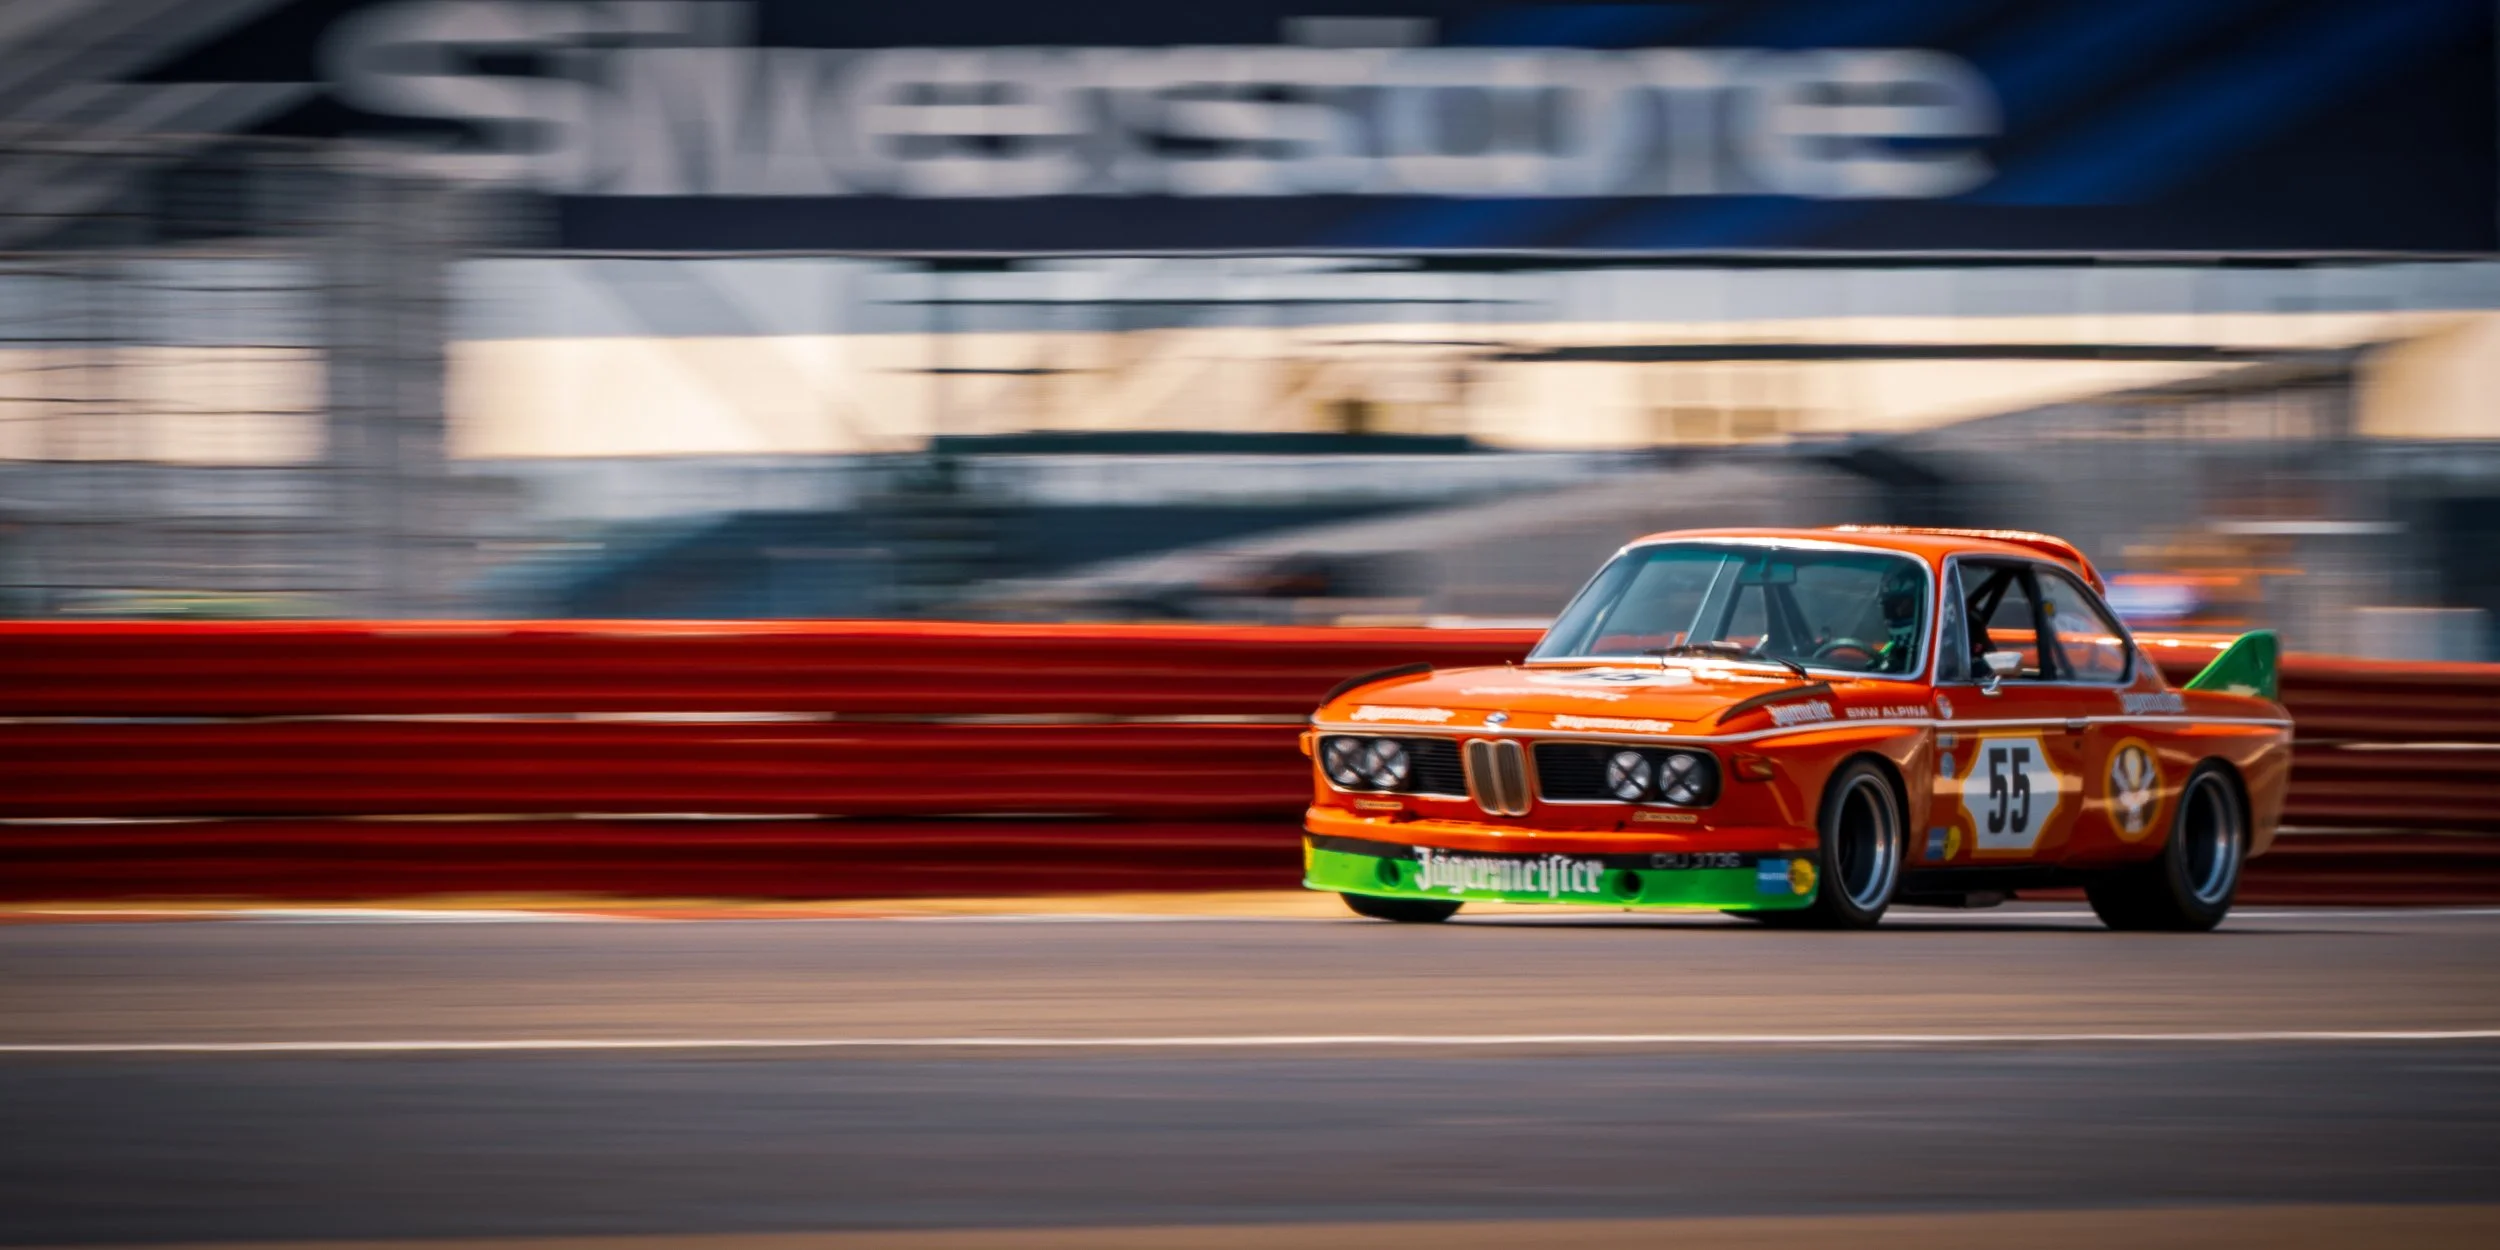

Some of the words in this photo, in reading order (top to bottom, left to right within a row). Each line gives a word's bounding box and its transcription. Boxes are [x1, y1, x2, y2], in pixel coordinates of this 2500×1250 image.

[1845, 707, 1879, 718] BMW
[1883, 705, 1929, 717] ALPINA
[1988, 747, 2031, 834] 55
[1412, 845, 1604, 898] Jägermeister
